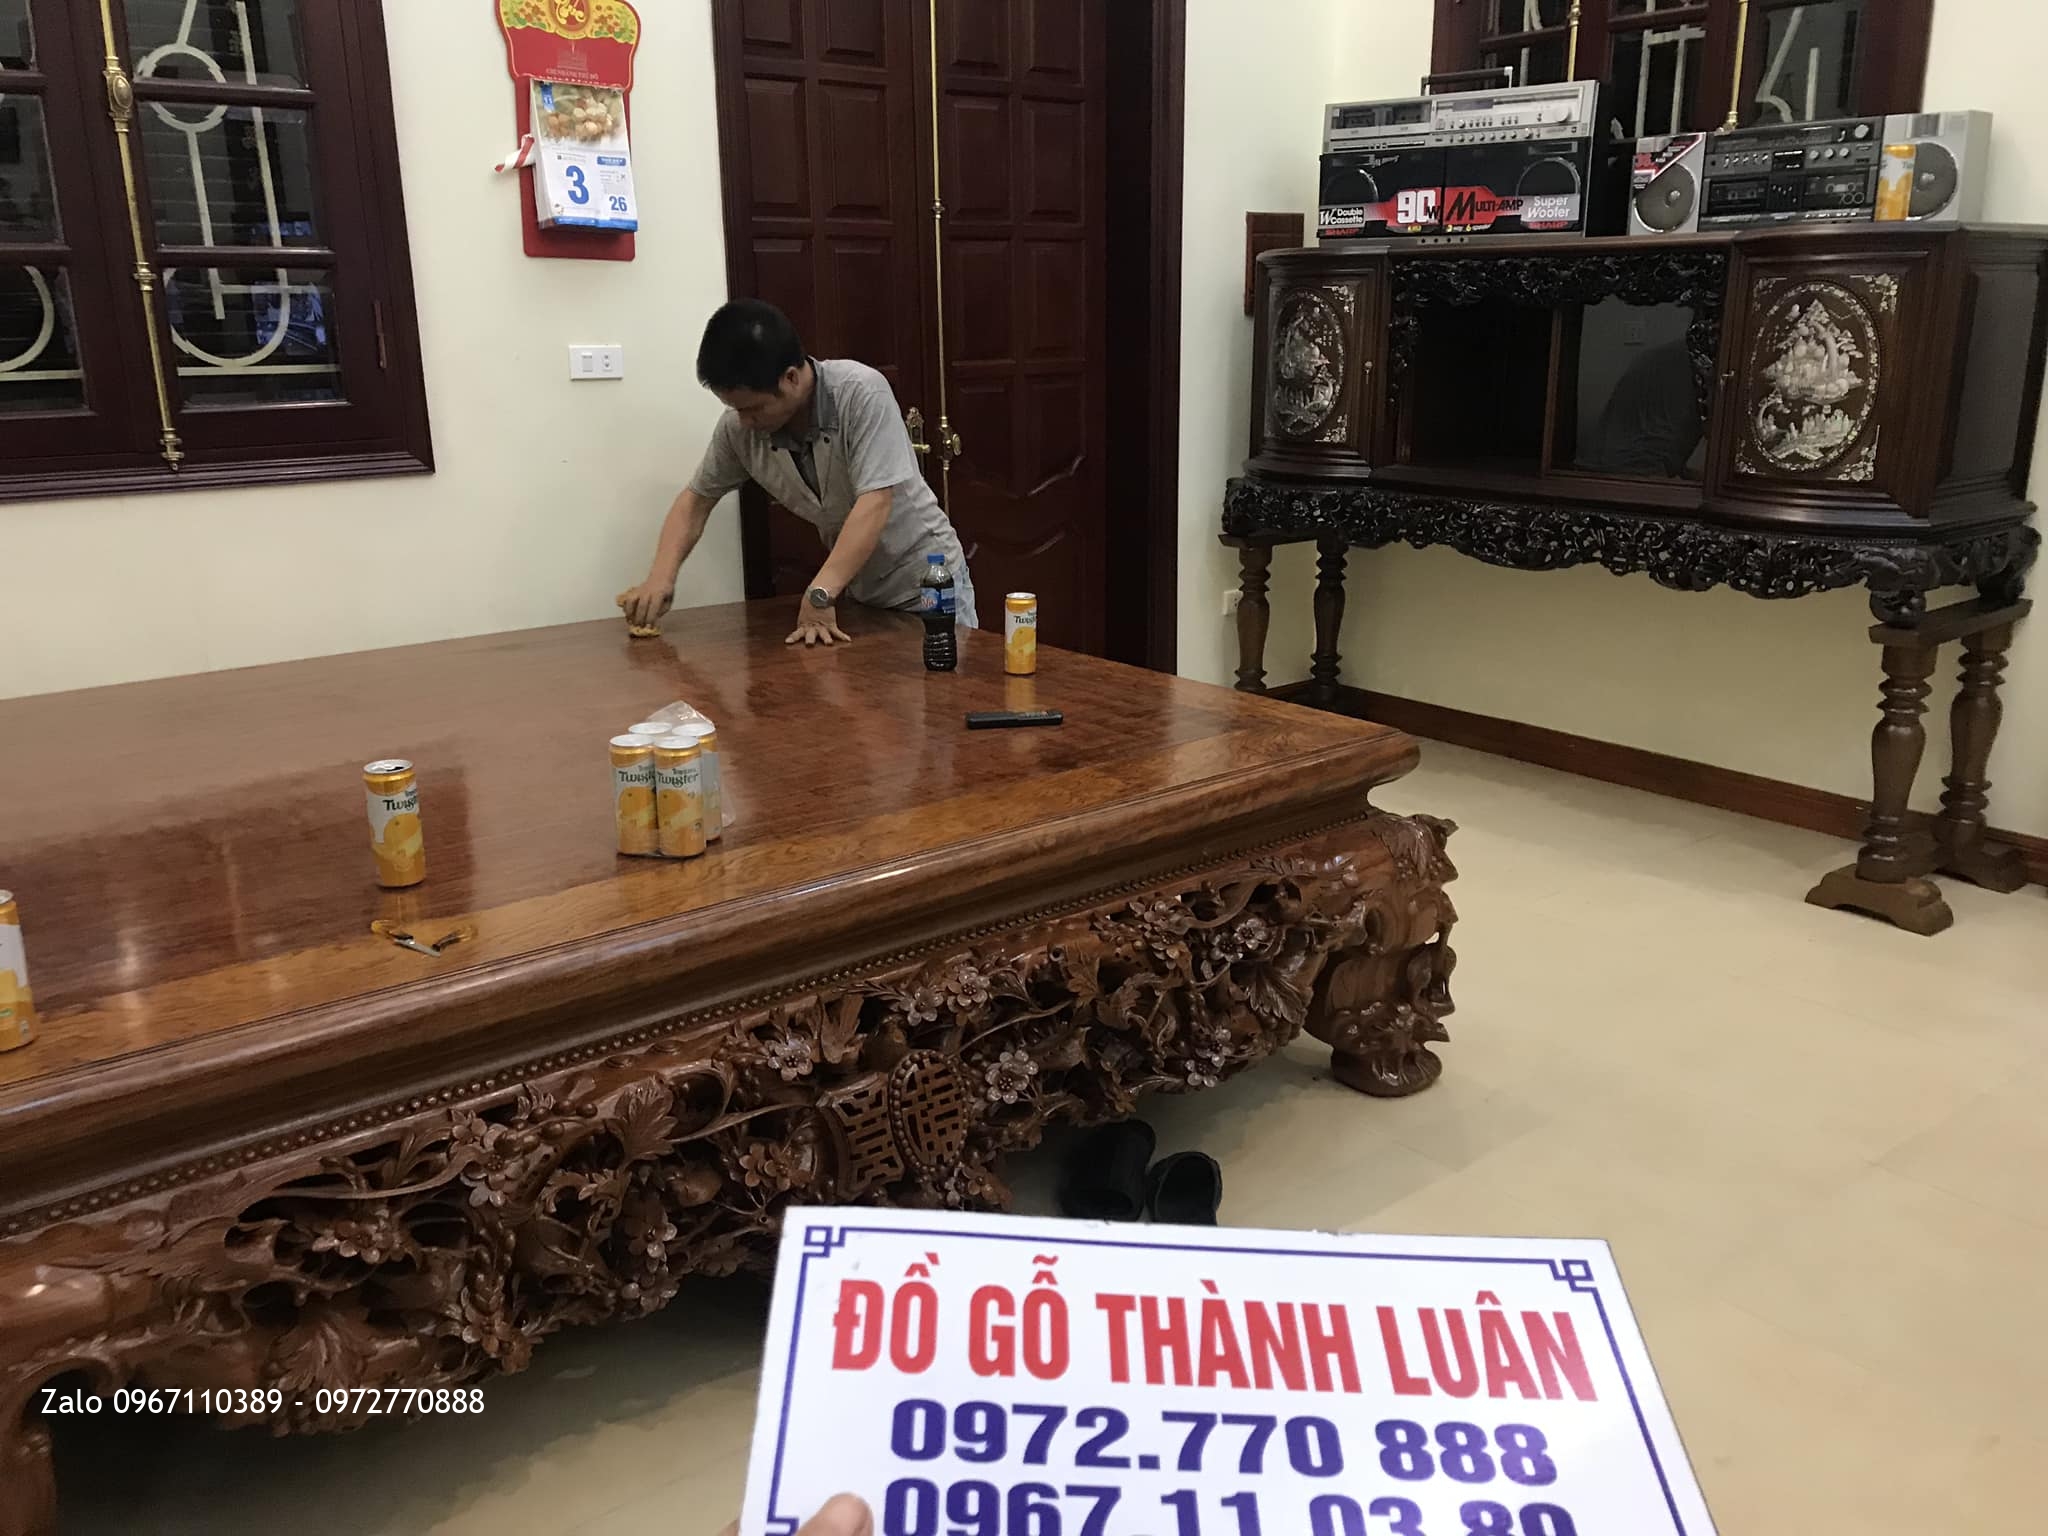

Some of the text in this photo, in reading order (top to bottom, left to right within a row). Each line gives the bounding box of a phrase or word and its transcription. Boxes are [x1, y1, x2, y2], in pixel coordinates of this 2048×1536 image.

[565, 165, 589, 205] 3
[609, 196, 628, 212] 26
[1534, 196, 1568, 208] Super
[1330, 215, 1363, 225] Cassette
[1337, 207, 1363, 217] Double
[1527, 207, 1570, 219] Woofer
[657, 772, 699, 788] Twister
[832, 1252, 1598, 1402] ĐỒ GỖ THÀNH LUÂN
[891, 1399, 1558, 1486] 0972.770 888
